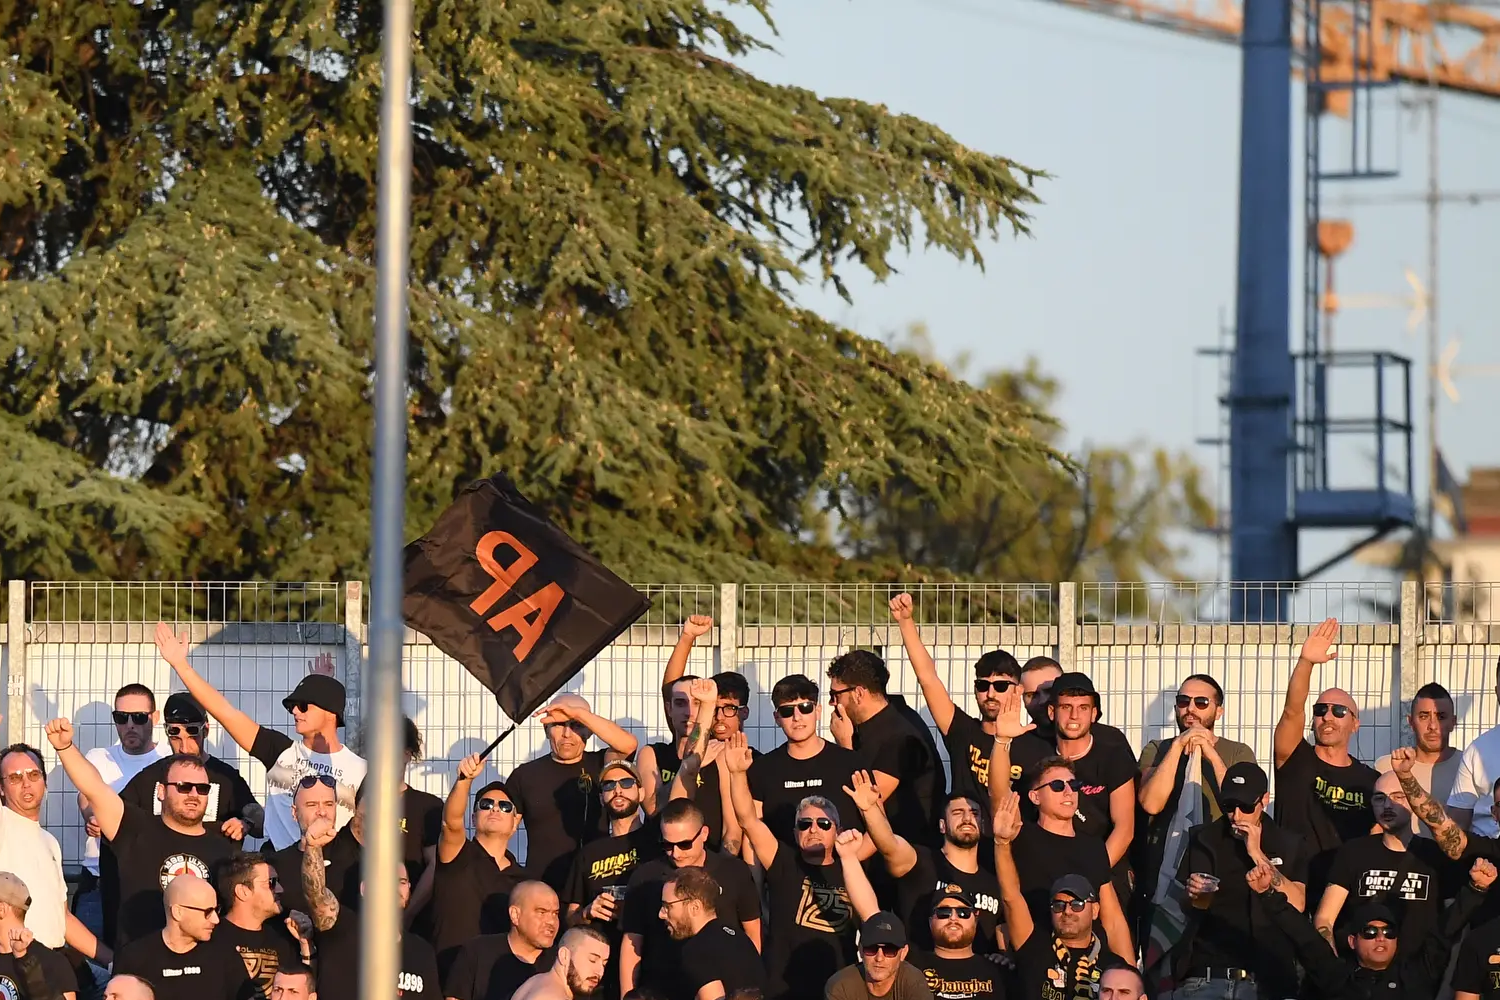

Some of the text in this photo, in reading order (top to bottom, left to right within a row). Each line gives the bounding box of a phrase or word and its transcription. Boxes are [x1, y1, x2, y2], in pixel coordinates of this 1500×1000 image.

[296, 758, 343, 777] METROPOLIS
[806, 779, 823, 787] 1898
[188, 857, 211, 880] ULTRAS
[1365, 876, 1423, 889] DIFFIATI
[974, 892, 999, 915] 1898
[1, 977, 18, 1000] ULTRAS
[398, 972, 424, 993] 1898
[923, 968, 993, 993] Shanghai
[936, 992, 974, 1000] ASCOLI
